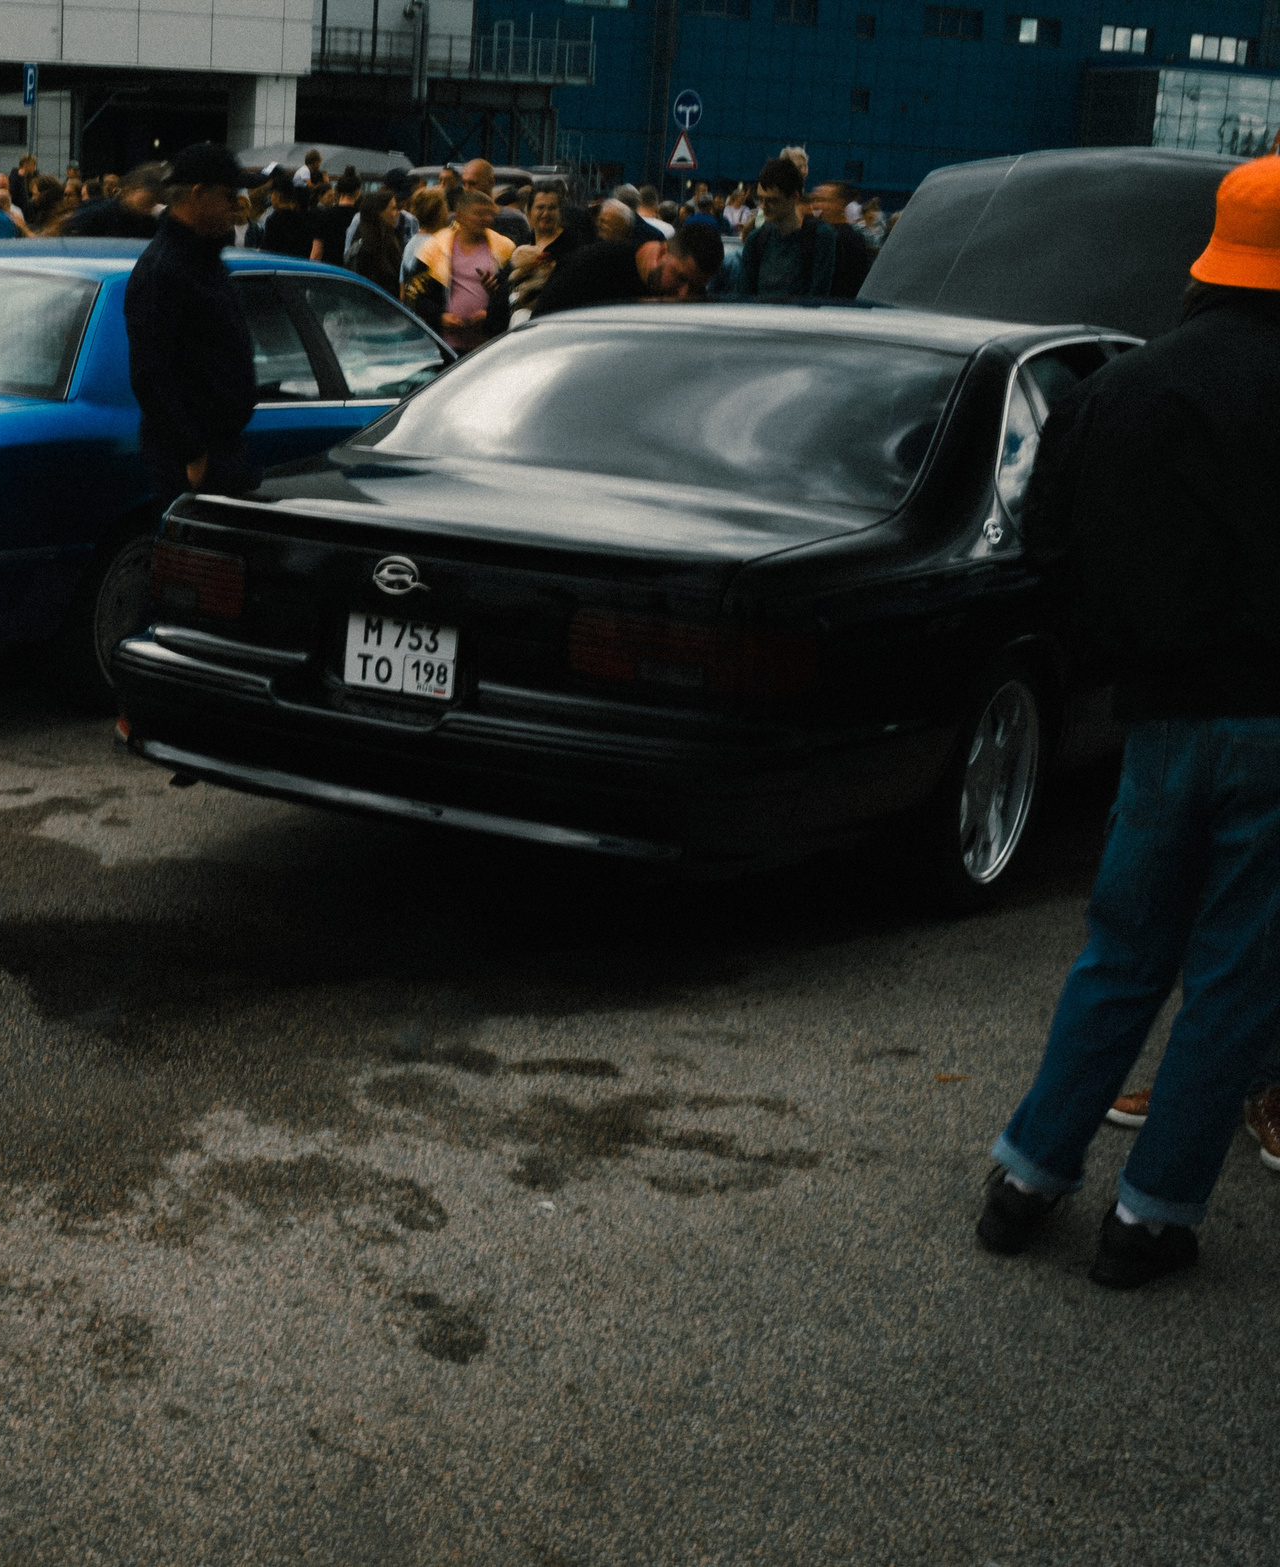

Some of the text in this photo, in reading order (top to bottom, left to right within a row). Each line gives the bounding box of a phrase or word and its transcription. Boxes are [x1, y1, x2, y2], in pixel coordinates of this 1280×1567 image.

[392, 618, 440, 653] 753
[357, 652, 448, 685] TO 198
